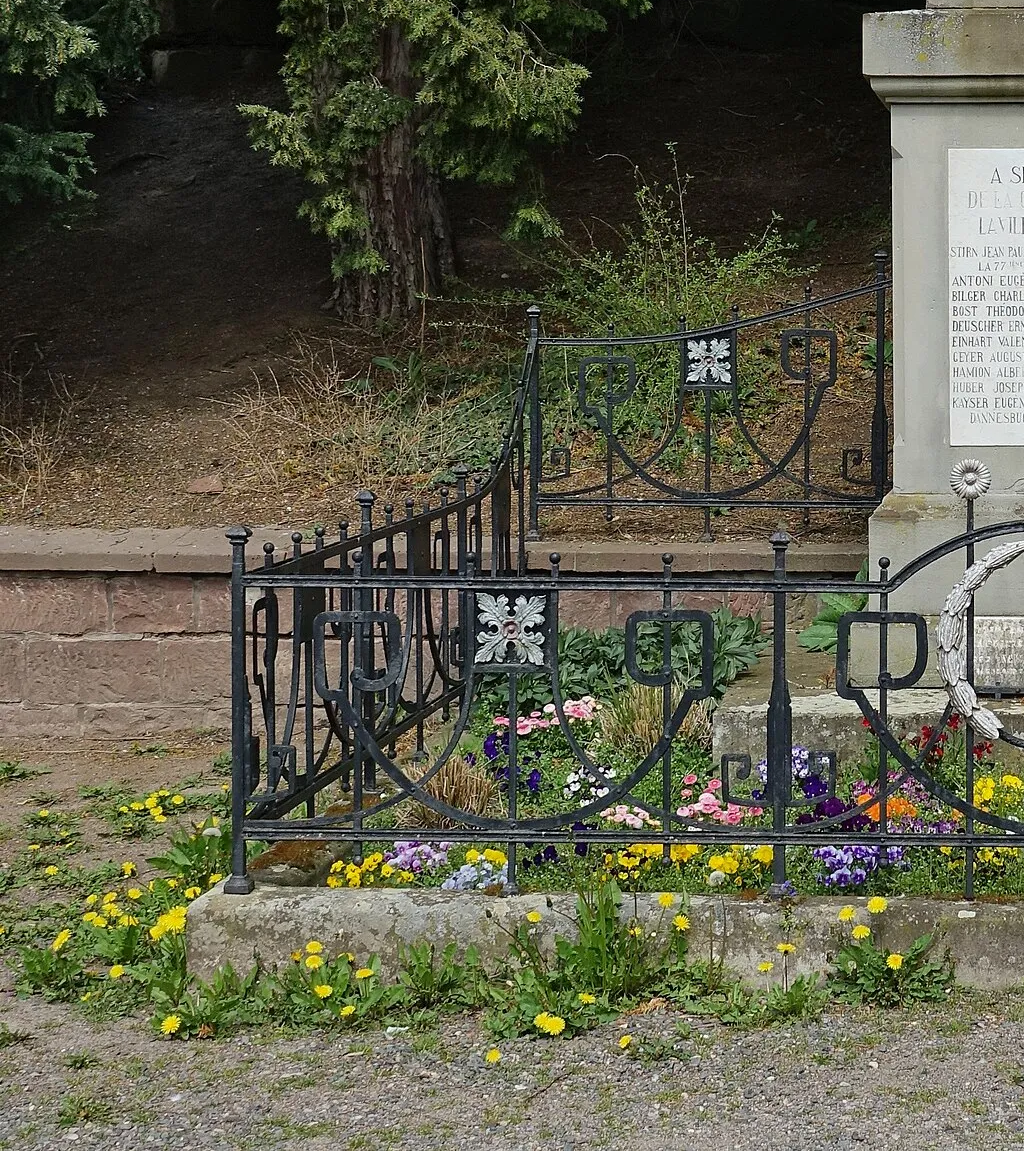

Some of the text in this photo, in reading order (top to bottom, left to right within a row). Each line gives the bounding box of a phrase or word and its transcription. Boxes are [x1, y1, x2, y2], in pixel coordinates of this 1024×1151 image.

[990, 167, 1003, 184] A
[968, 190, 988, 209] DE
[994, 190, 1013, 208] LA
[978, 216, 998, 235] LA
[950, 246, 978, 258] STIRN
[982, 246, 1005, 258] JEAN
[978, 261, 991, 271] LA
[952, 275, 993, 286] ANTONI
[952, 290, 986, 301] BILGER
[952, 305, 978, 317] BOST
[952, 321, 1003, 332] DEUSCHER
[952, 336, 993, 347] EINHART
[953, 351, 984, 363] GEYER
[953, 366, 991, 378] HAMION
[953, 382, 985, 393] HUBER
[952, 397, 989, 409] KAYSER
